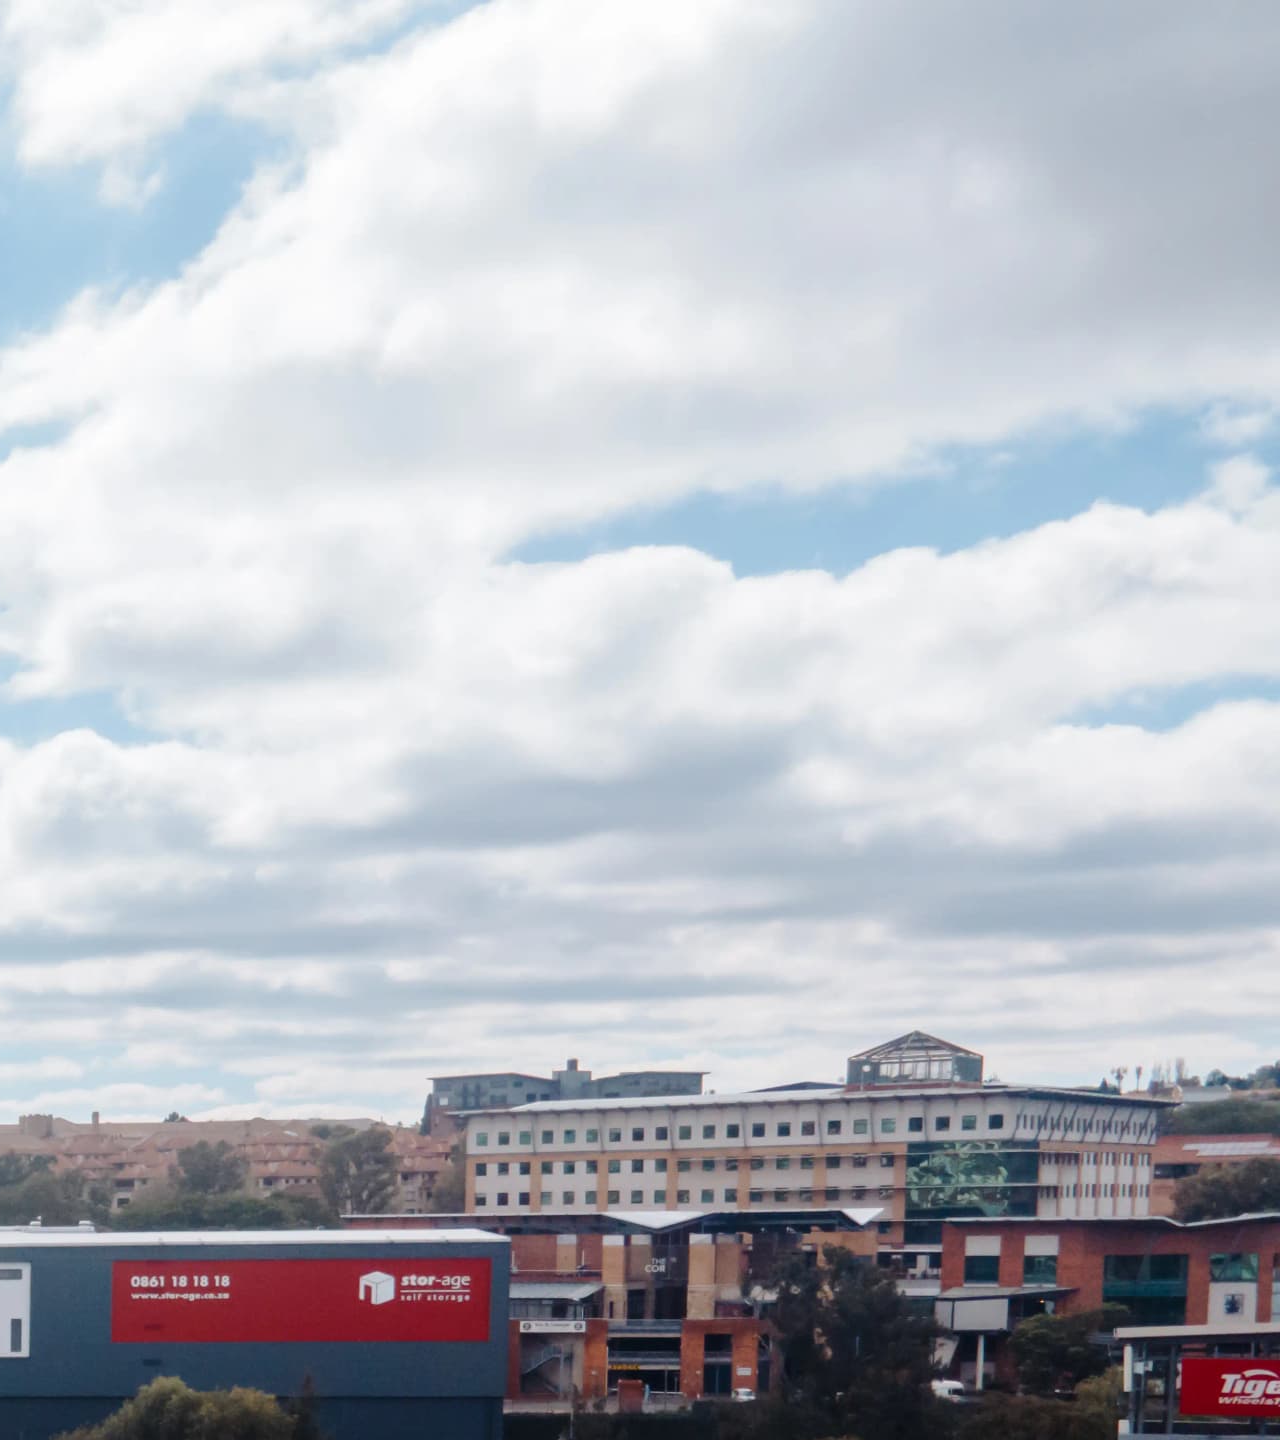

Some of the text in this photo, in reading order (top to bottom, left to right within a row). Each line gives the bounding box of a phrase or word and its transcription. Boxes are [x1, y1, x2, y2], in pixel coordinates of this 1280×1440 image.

[130, 1275, 230, 1288] 0861 18 18 18
[400, 1274, 471, 1289] stor-age
[400, 1293, 471, 1303] self storage
